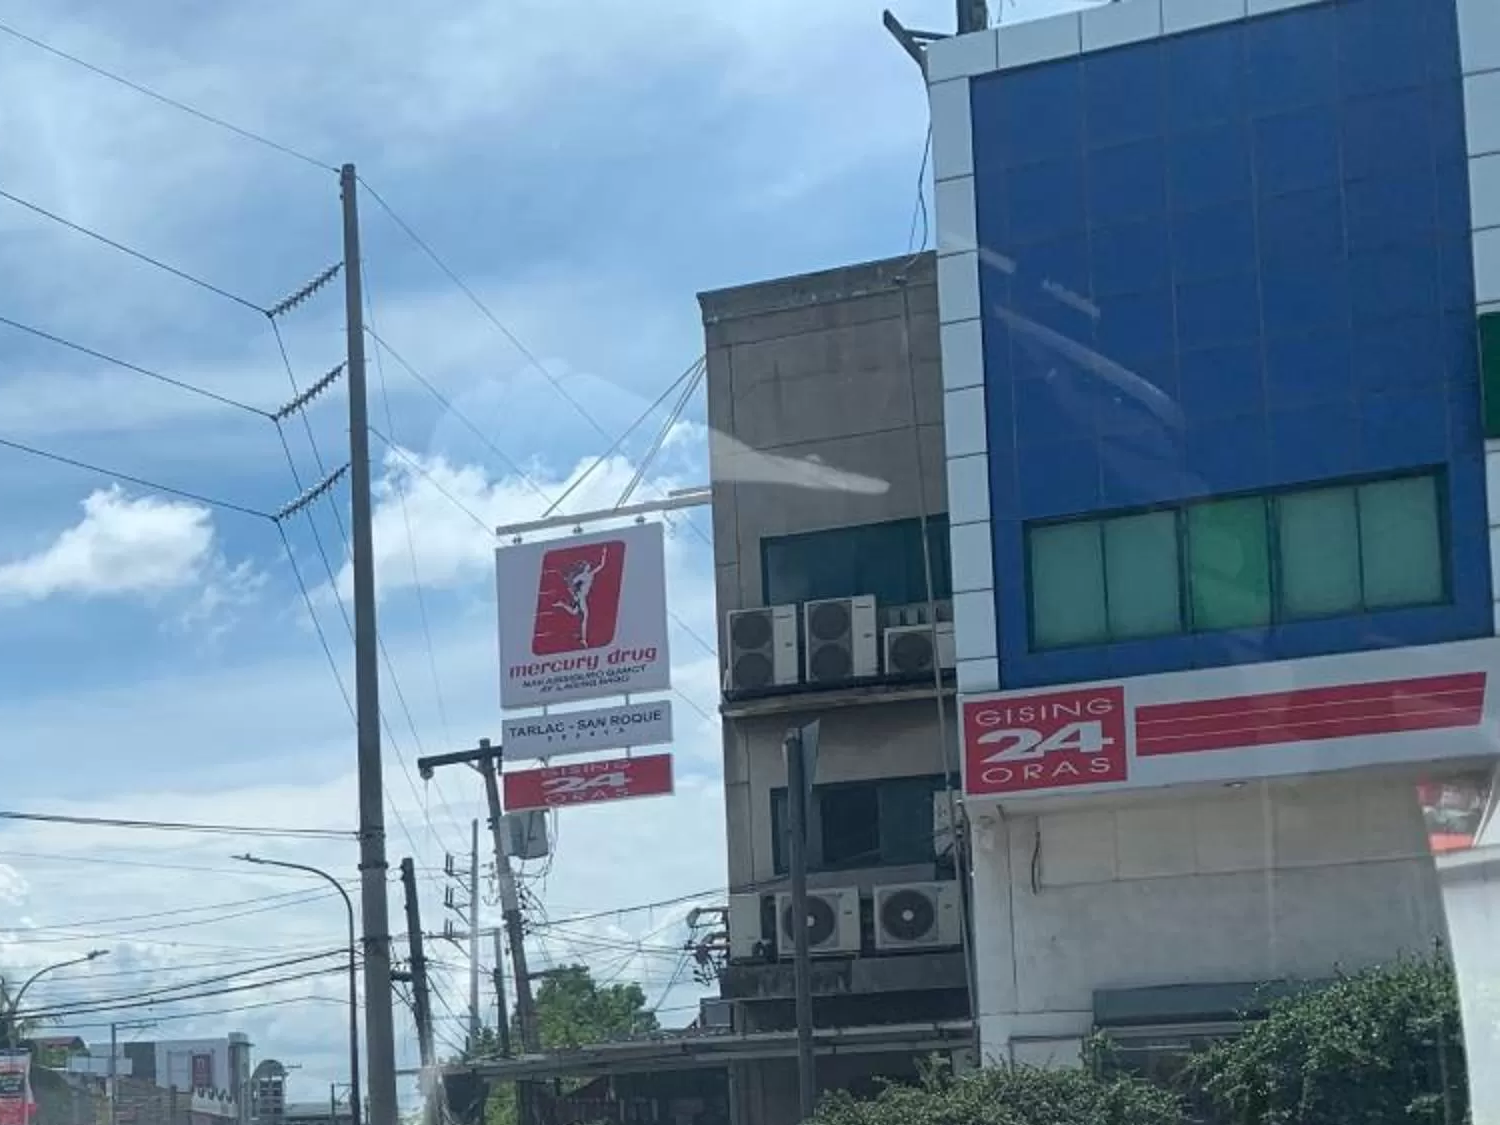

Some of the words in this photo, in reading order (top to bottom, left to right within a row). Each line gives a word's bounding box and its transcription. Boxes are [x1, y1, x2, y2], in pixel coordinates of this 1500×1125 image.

[509, 655, 599, 679] mercury
[607, 647, 657, 665] drug
[509, 722, 565, 738] TARLAC
[577, 718, 605, 731] SAN
[610, 710, 661, 726] ROQUE
[975, 697, 1113, 726] GISING
[977, 719, 1115, 764] 24
[541, 772, 632, 795] 24
[981, 757, 1111, 784] ORAS
